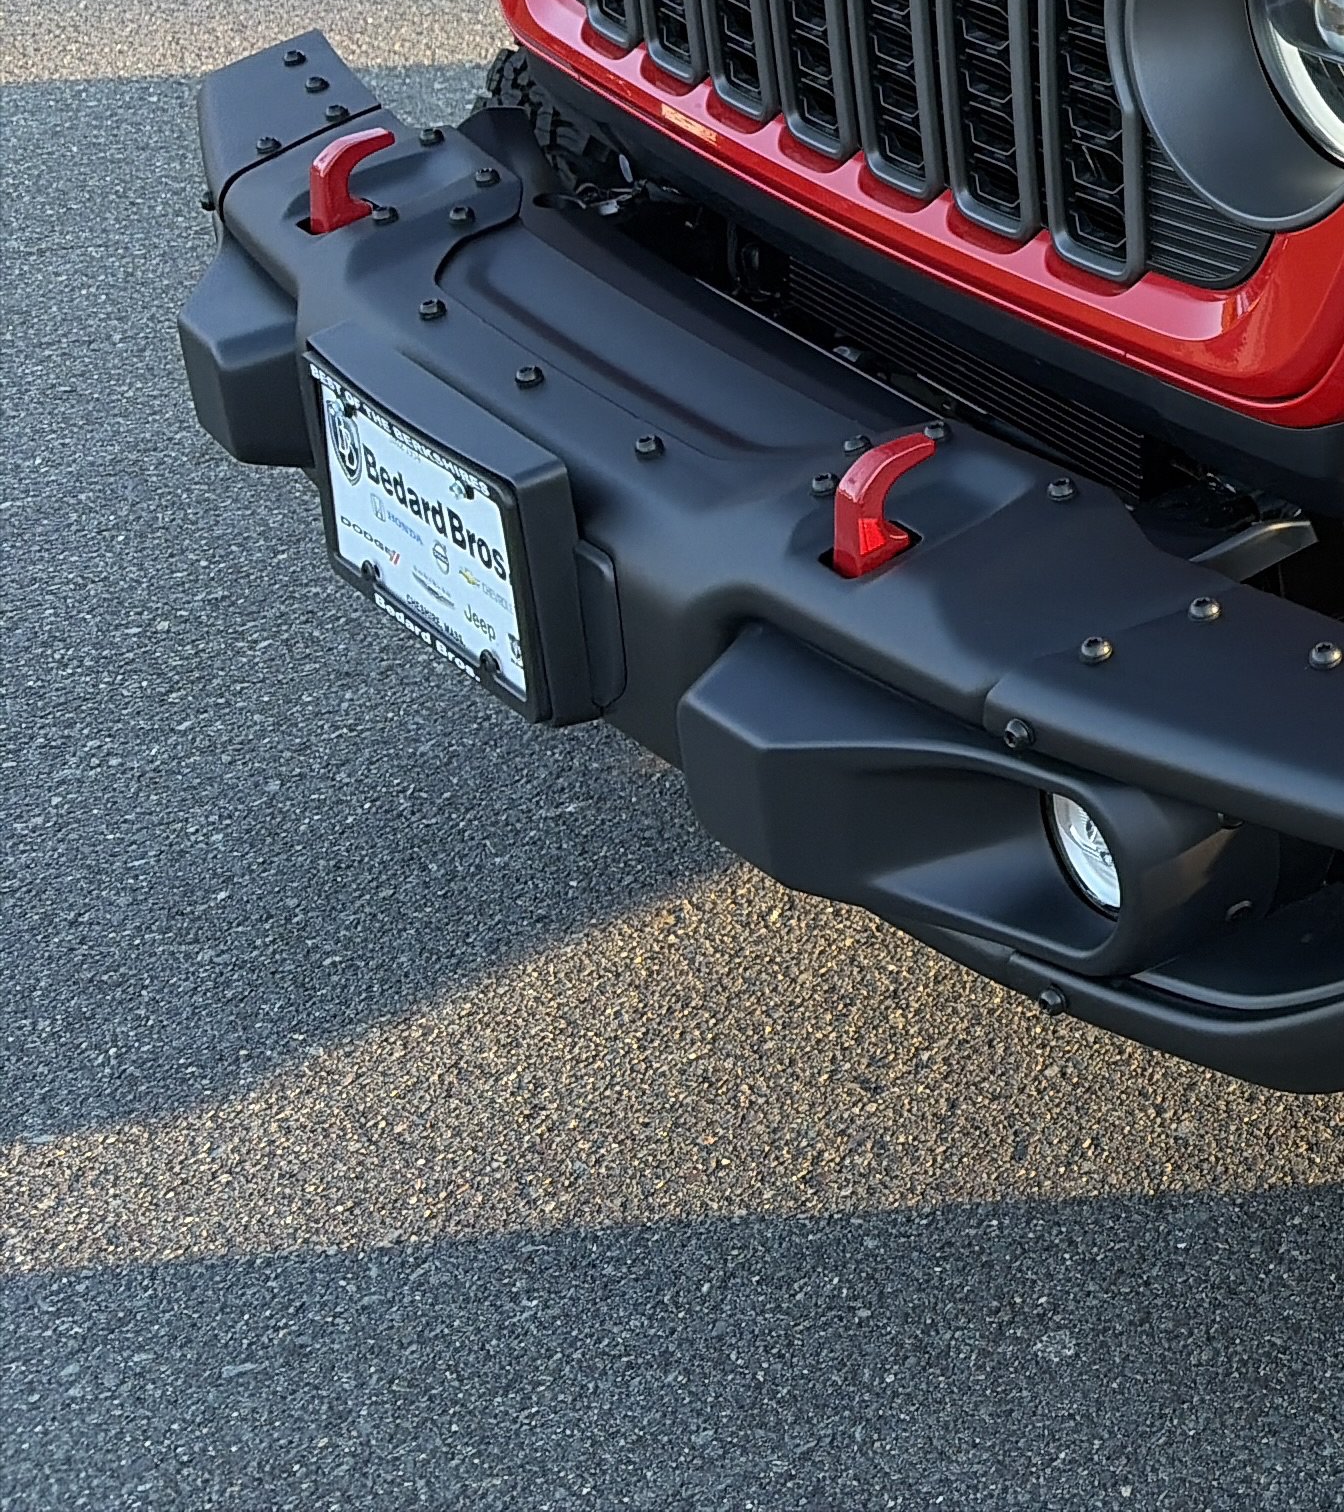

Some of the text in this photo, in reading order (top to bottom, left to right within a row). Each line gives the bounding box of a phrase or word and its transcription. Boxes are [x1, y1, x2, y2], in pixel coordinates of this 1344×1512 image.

[310, 362, 342, 395] BEST
[344, 390, 362, 409] OF
[362, 402, 393, 434] THE
[394, 426, 491, 497] BERKSHIRES
[374, 592, 432, 645] Bedard
[434, 639, 482, 683] Bros.
[463, 603, 497, 642] Jeep
